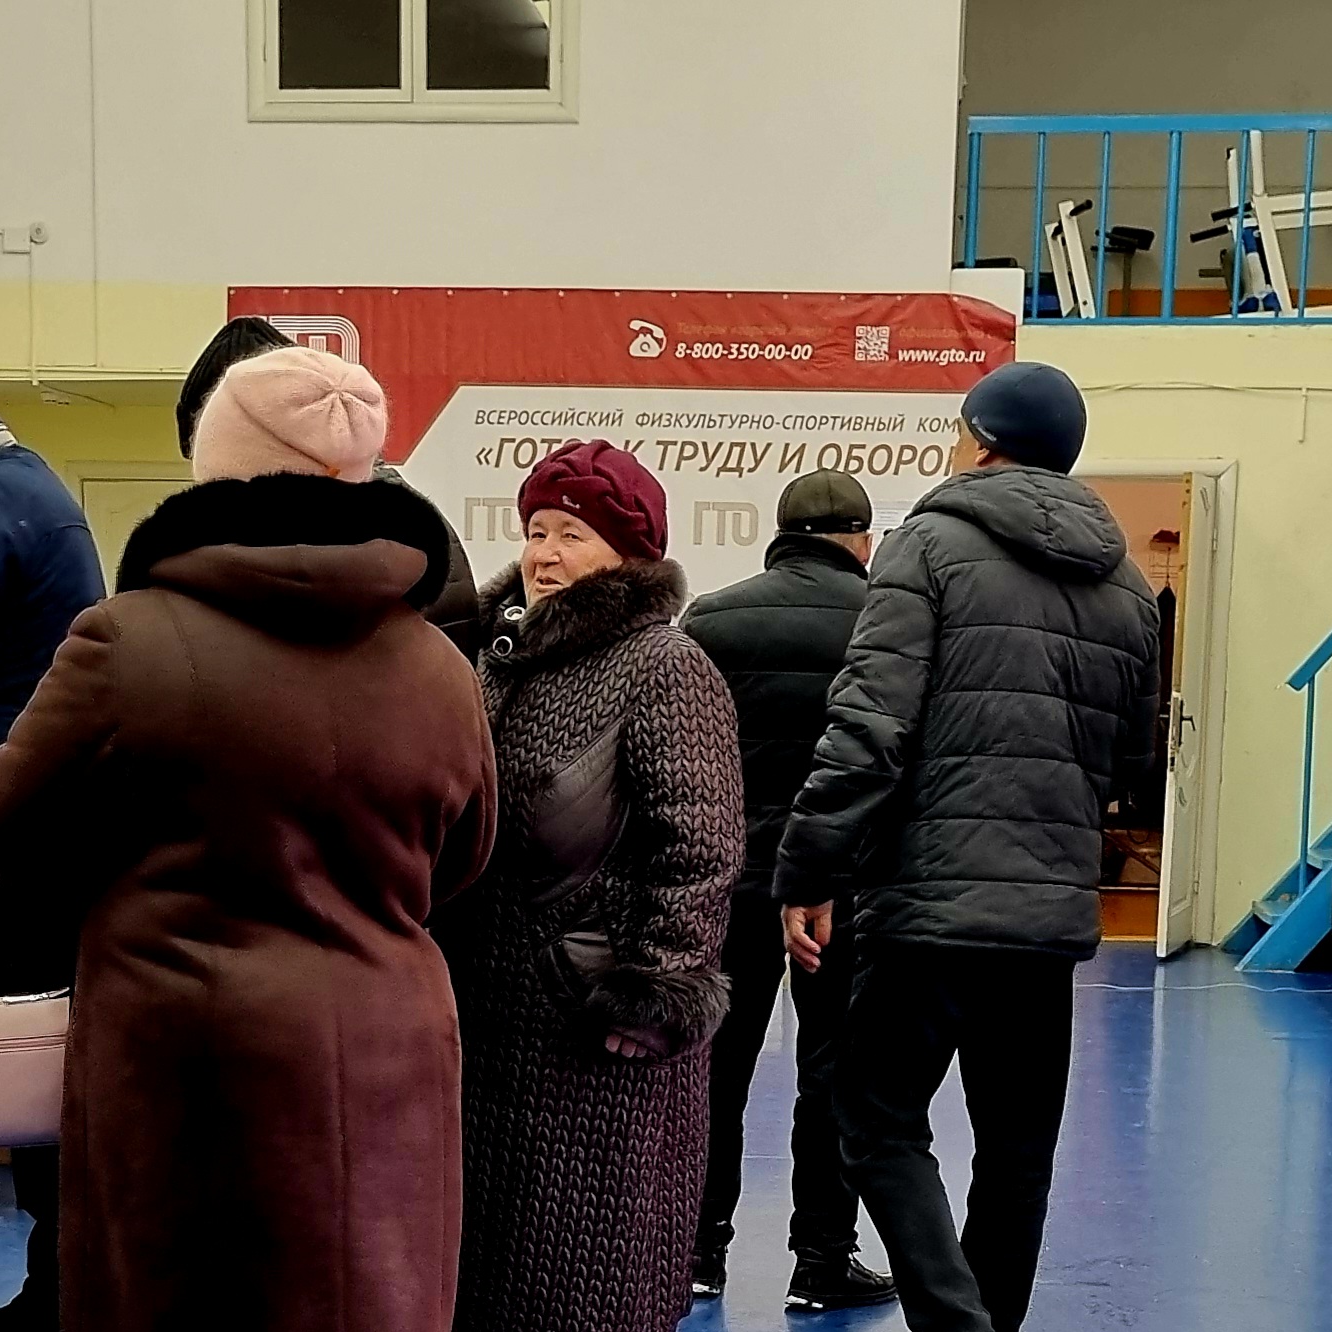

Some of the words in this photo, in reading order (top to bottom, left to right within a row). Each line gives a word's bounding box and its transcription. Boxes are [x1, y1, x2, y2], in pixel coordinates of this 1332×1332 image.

[674, 342, 813, 361] 8-800-350-00-00
[898, 348, 986, 366] www.gto.ru
[474, 407, 624, 427] ВСЕРОССИЙСКИЙ
[635, 411, 906, 433] ФИЗКУЛЬТУРНО-СПОРТИВНЫЙ
[916, 416, 959, 433] КОМ
[655, 439, 773, 478] ТРУДУ
[778, 442, 809, 474] И
[818, 442, 956, 477] ОБОРО
[693, 500, 759, 547] ГТО
